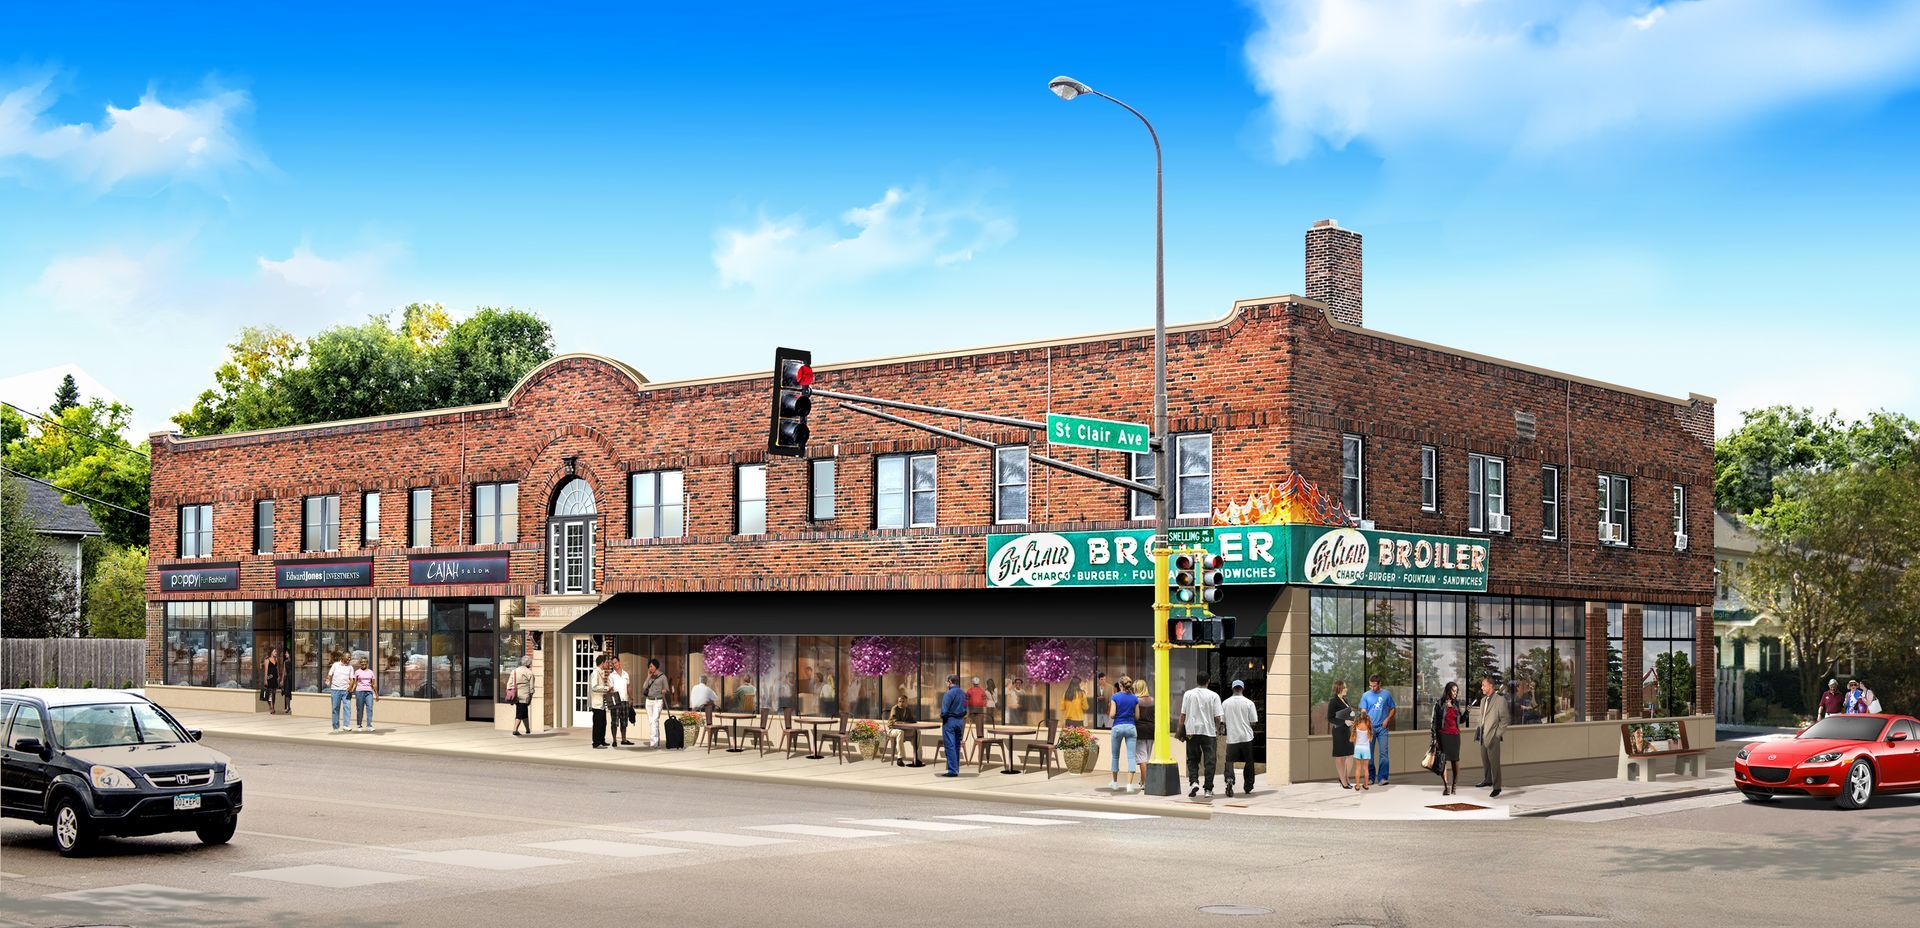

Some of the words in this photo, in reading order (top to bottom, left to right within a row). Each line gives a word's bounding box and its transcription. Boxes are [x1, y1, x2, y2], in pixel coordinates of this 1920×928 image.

[1055, 421, 1071, 439] St
[1077, 424, 1111, 442] Clair
[1118, 429, 1142, 445] Ave
[1168, 531, 1200, 541] SNELLING
[1087, 531, 1275, 566] BRER
[1378, 537, 1487, 573] BROILER
[171, 574, 198, 588] poppy
[427, 561, 459, 582] CAJAH
[1403, 573, 1436, 584] FOUNTAIN
[1443, 577, 1483, 586] SANDWICHES
